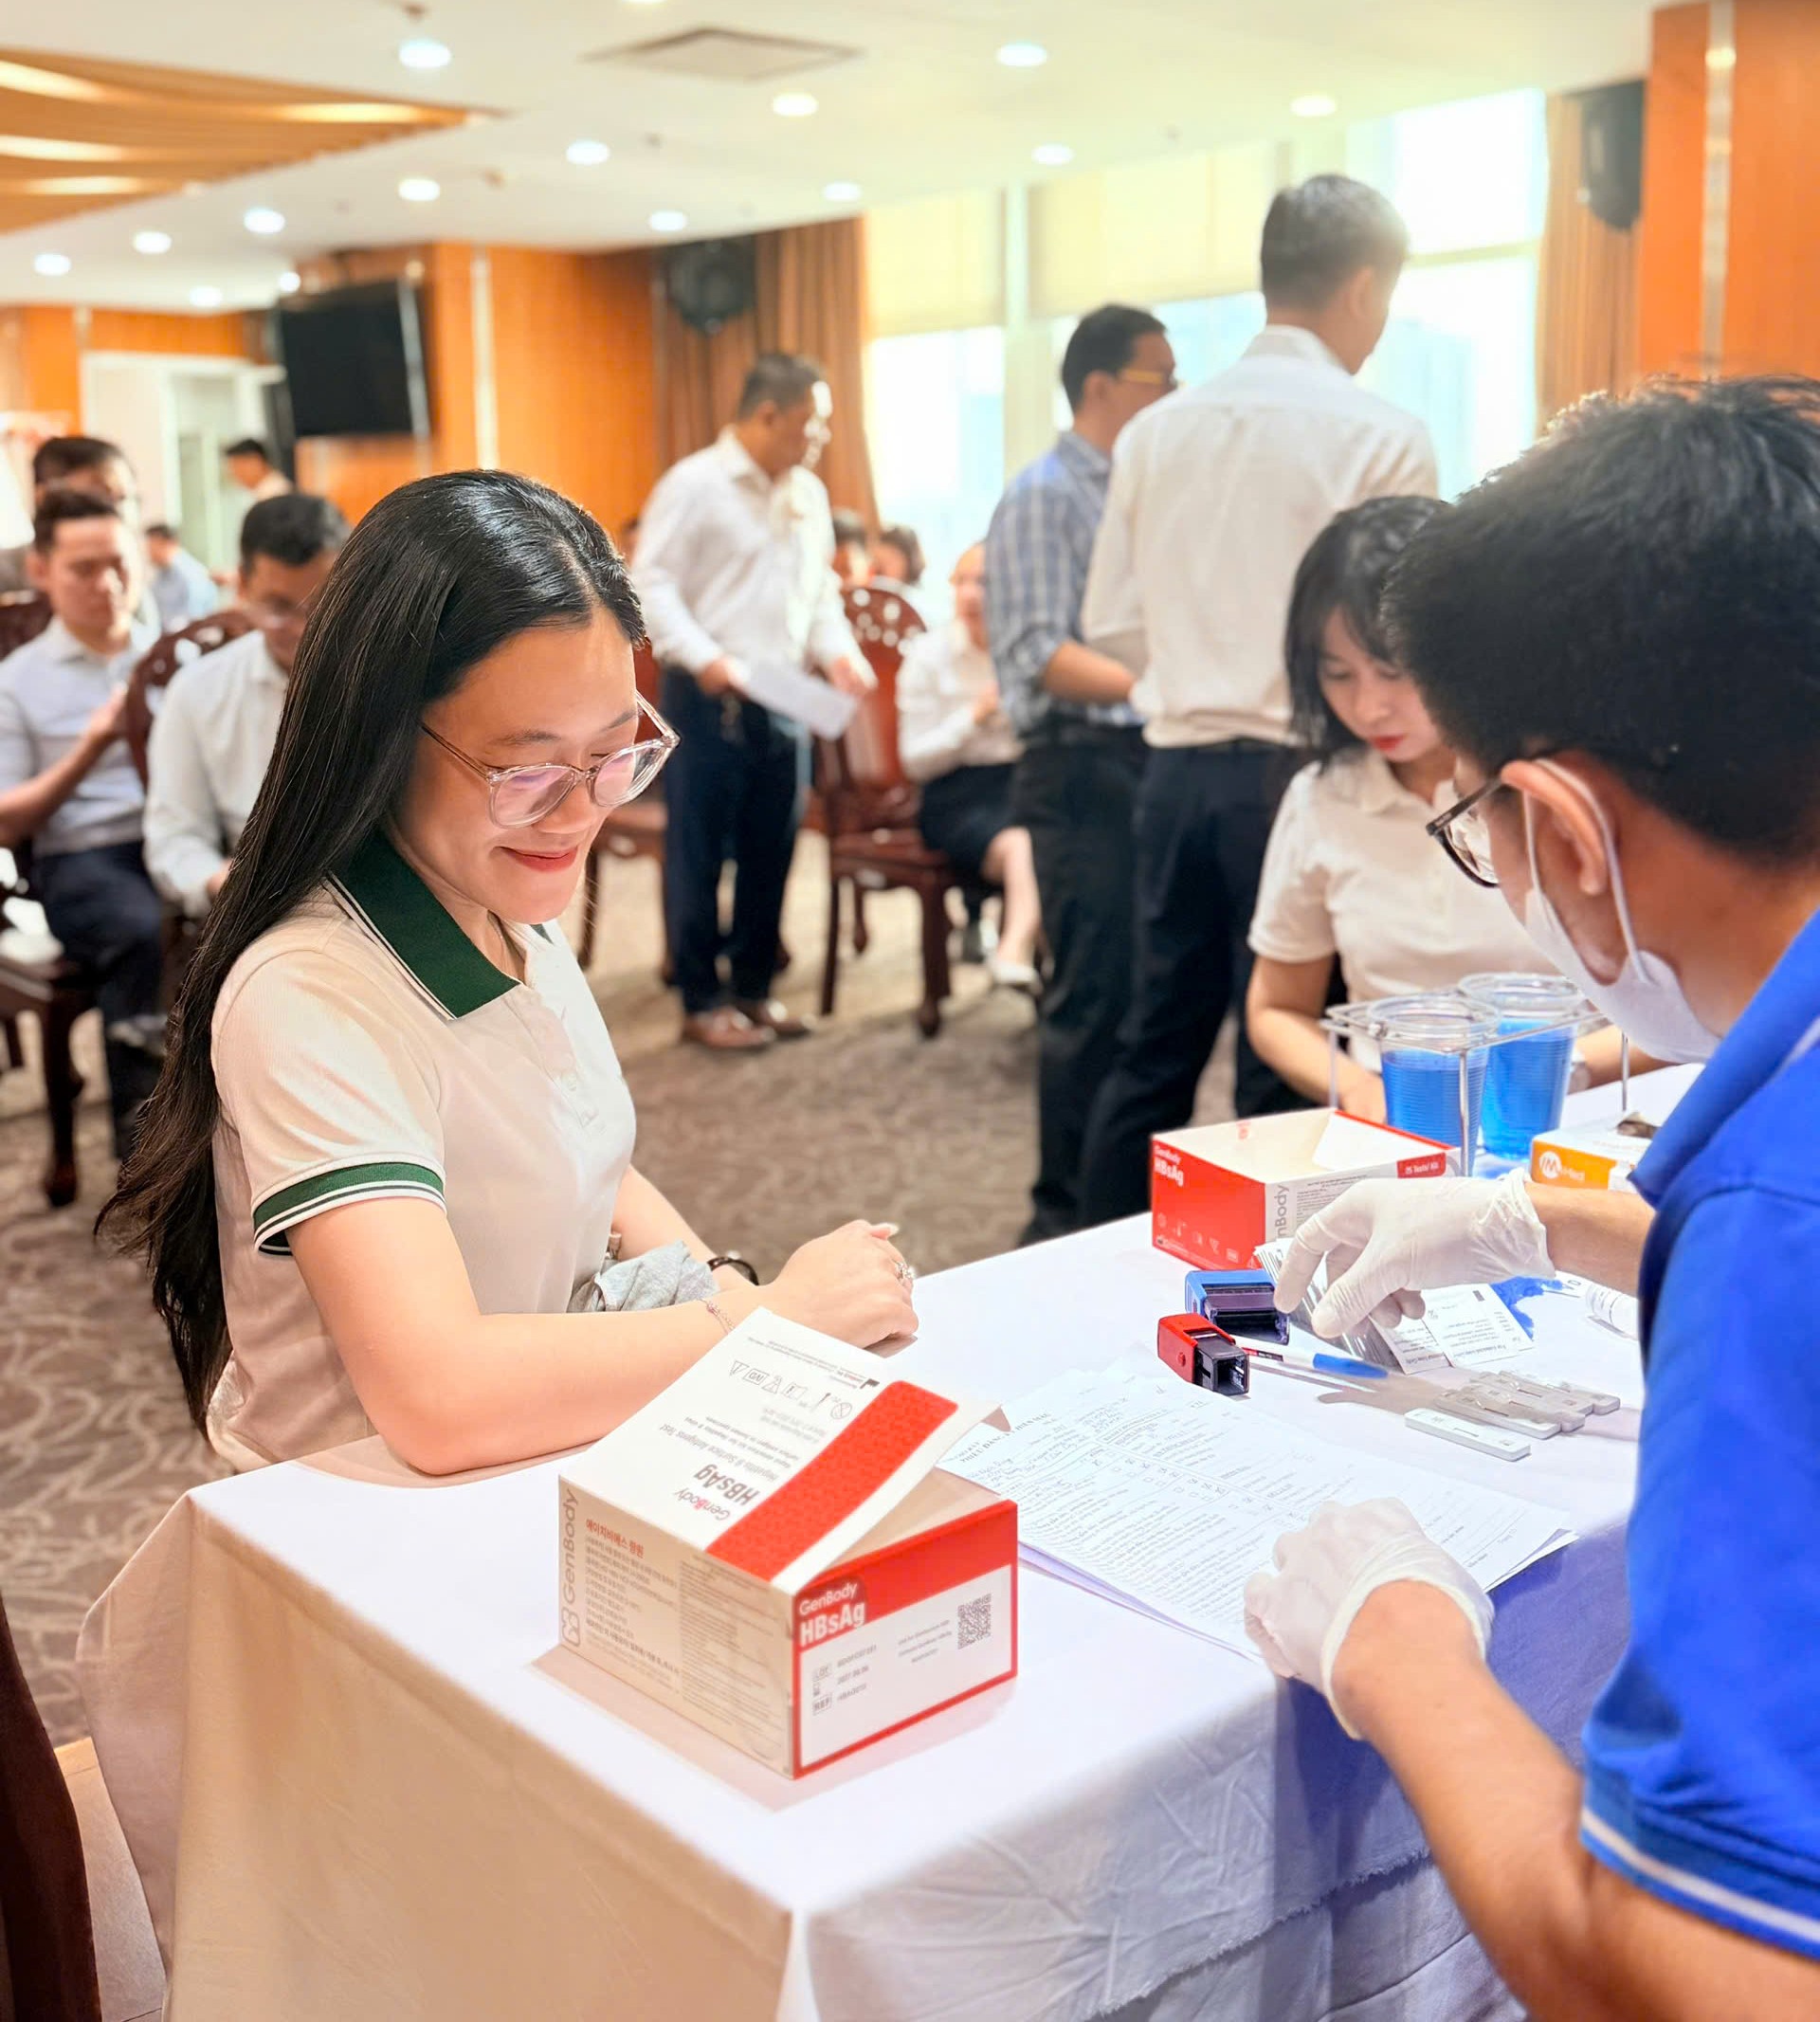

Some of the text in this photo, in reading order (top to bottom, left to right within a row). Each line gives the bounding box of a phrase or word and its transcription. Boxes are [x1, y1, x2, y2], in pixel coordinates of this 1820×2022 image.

[1154, 1157, 1184, 1187] HBsAg
[1274, 1185, 1289, 1237] nBody
[748, 1371, 764, 1381] IVD
[659, 1423, 678, 1436] Test
[705, 1446, 738, 1464] Surface
[693, 1464, 760, 1507] HBsAg
[674, 1487, 731, 1521] GenBody
[563, 1487, 579, 1605] GenBody
[799, 1581, 858, 1617] GenBody
[799, 1601, 866, 1648] HBsAg
